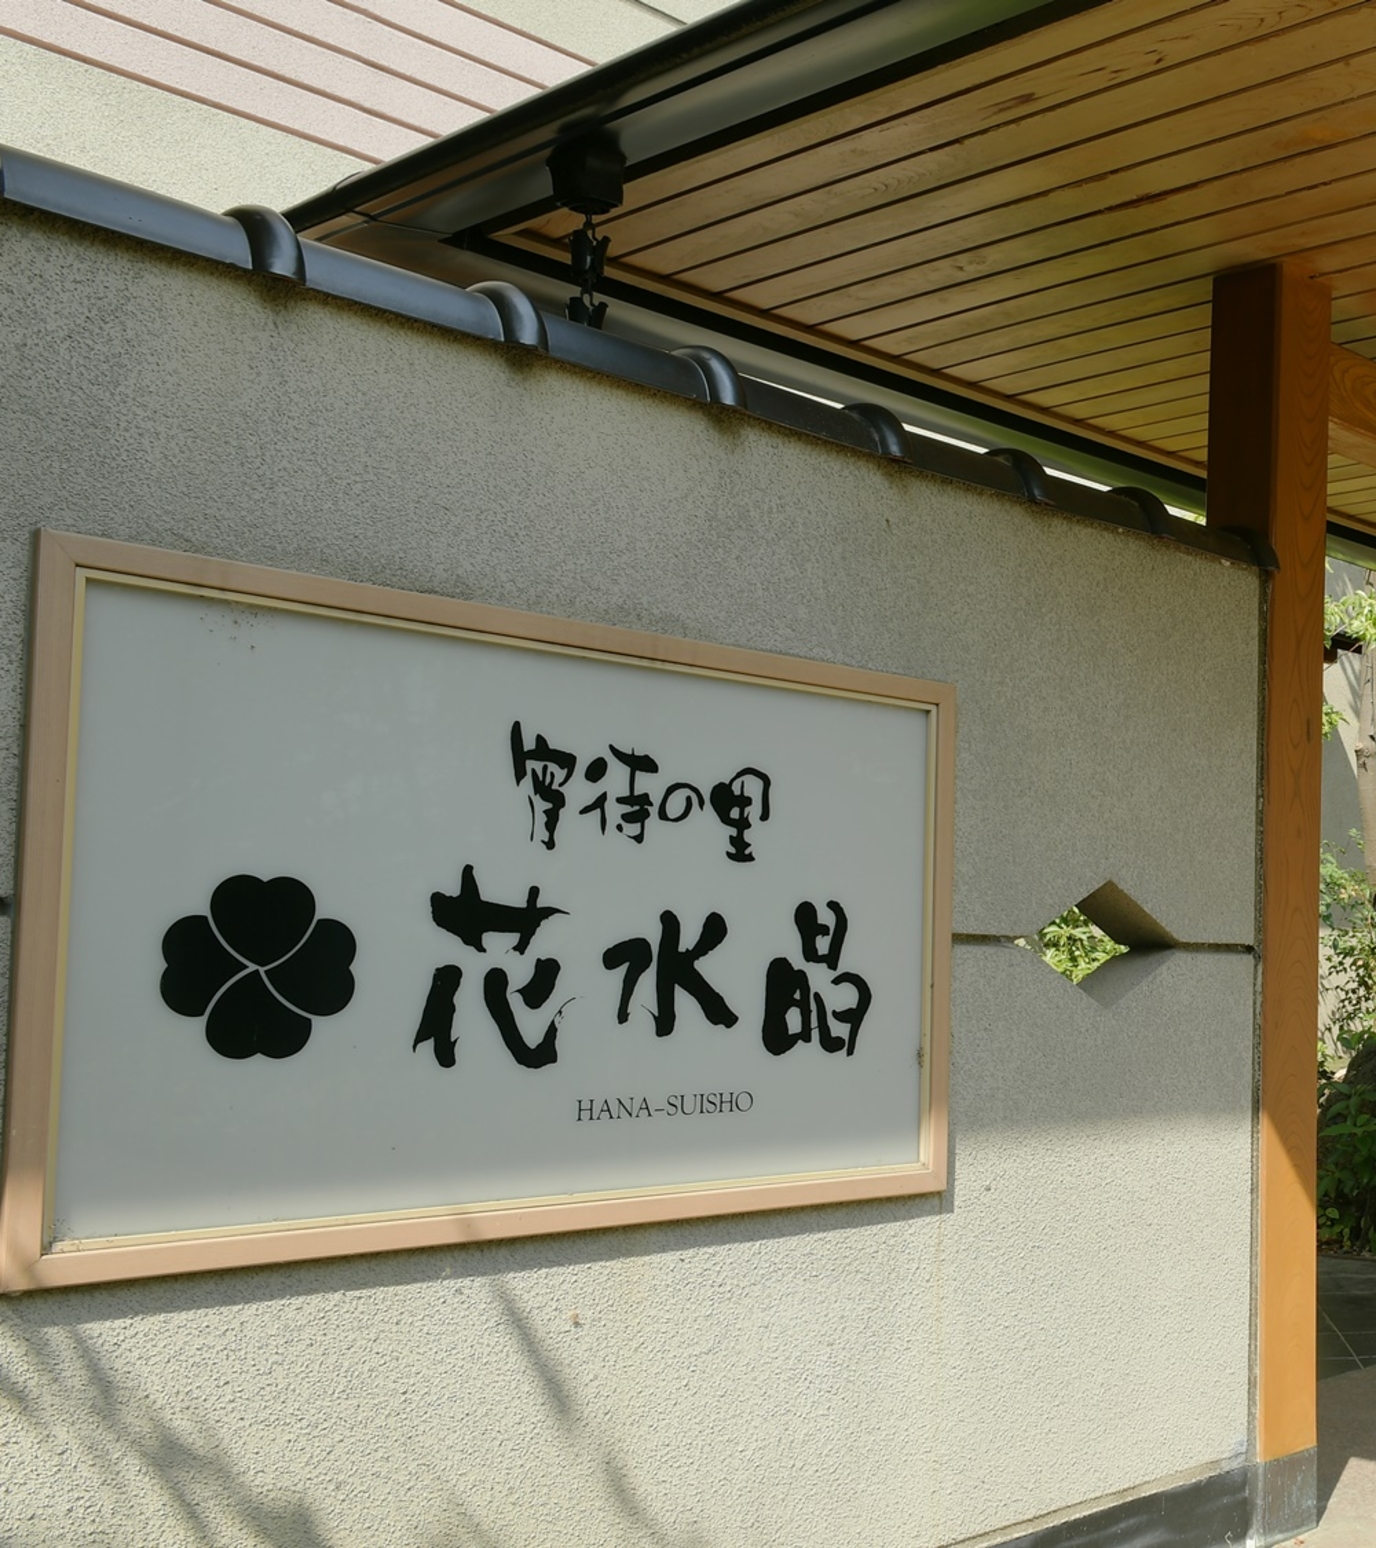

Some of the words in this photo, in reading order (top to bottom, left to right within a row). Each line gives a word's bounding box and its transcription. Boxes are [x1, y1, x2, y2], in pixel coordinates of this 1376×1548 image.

[412, 864, 872, 1069] 花水晶
[576, 1091, 754, 1121] HANA-SUISHO
